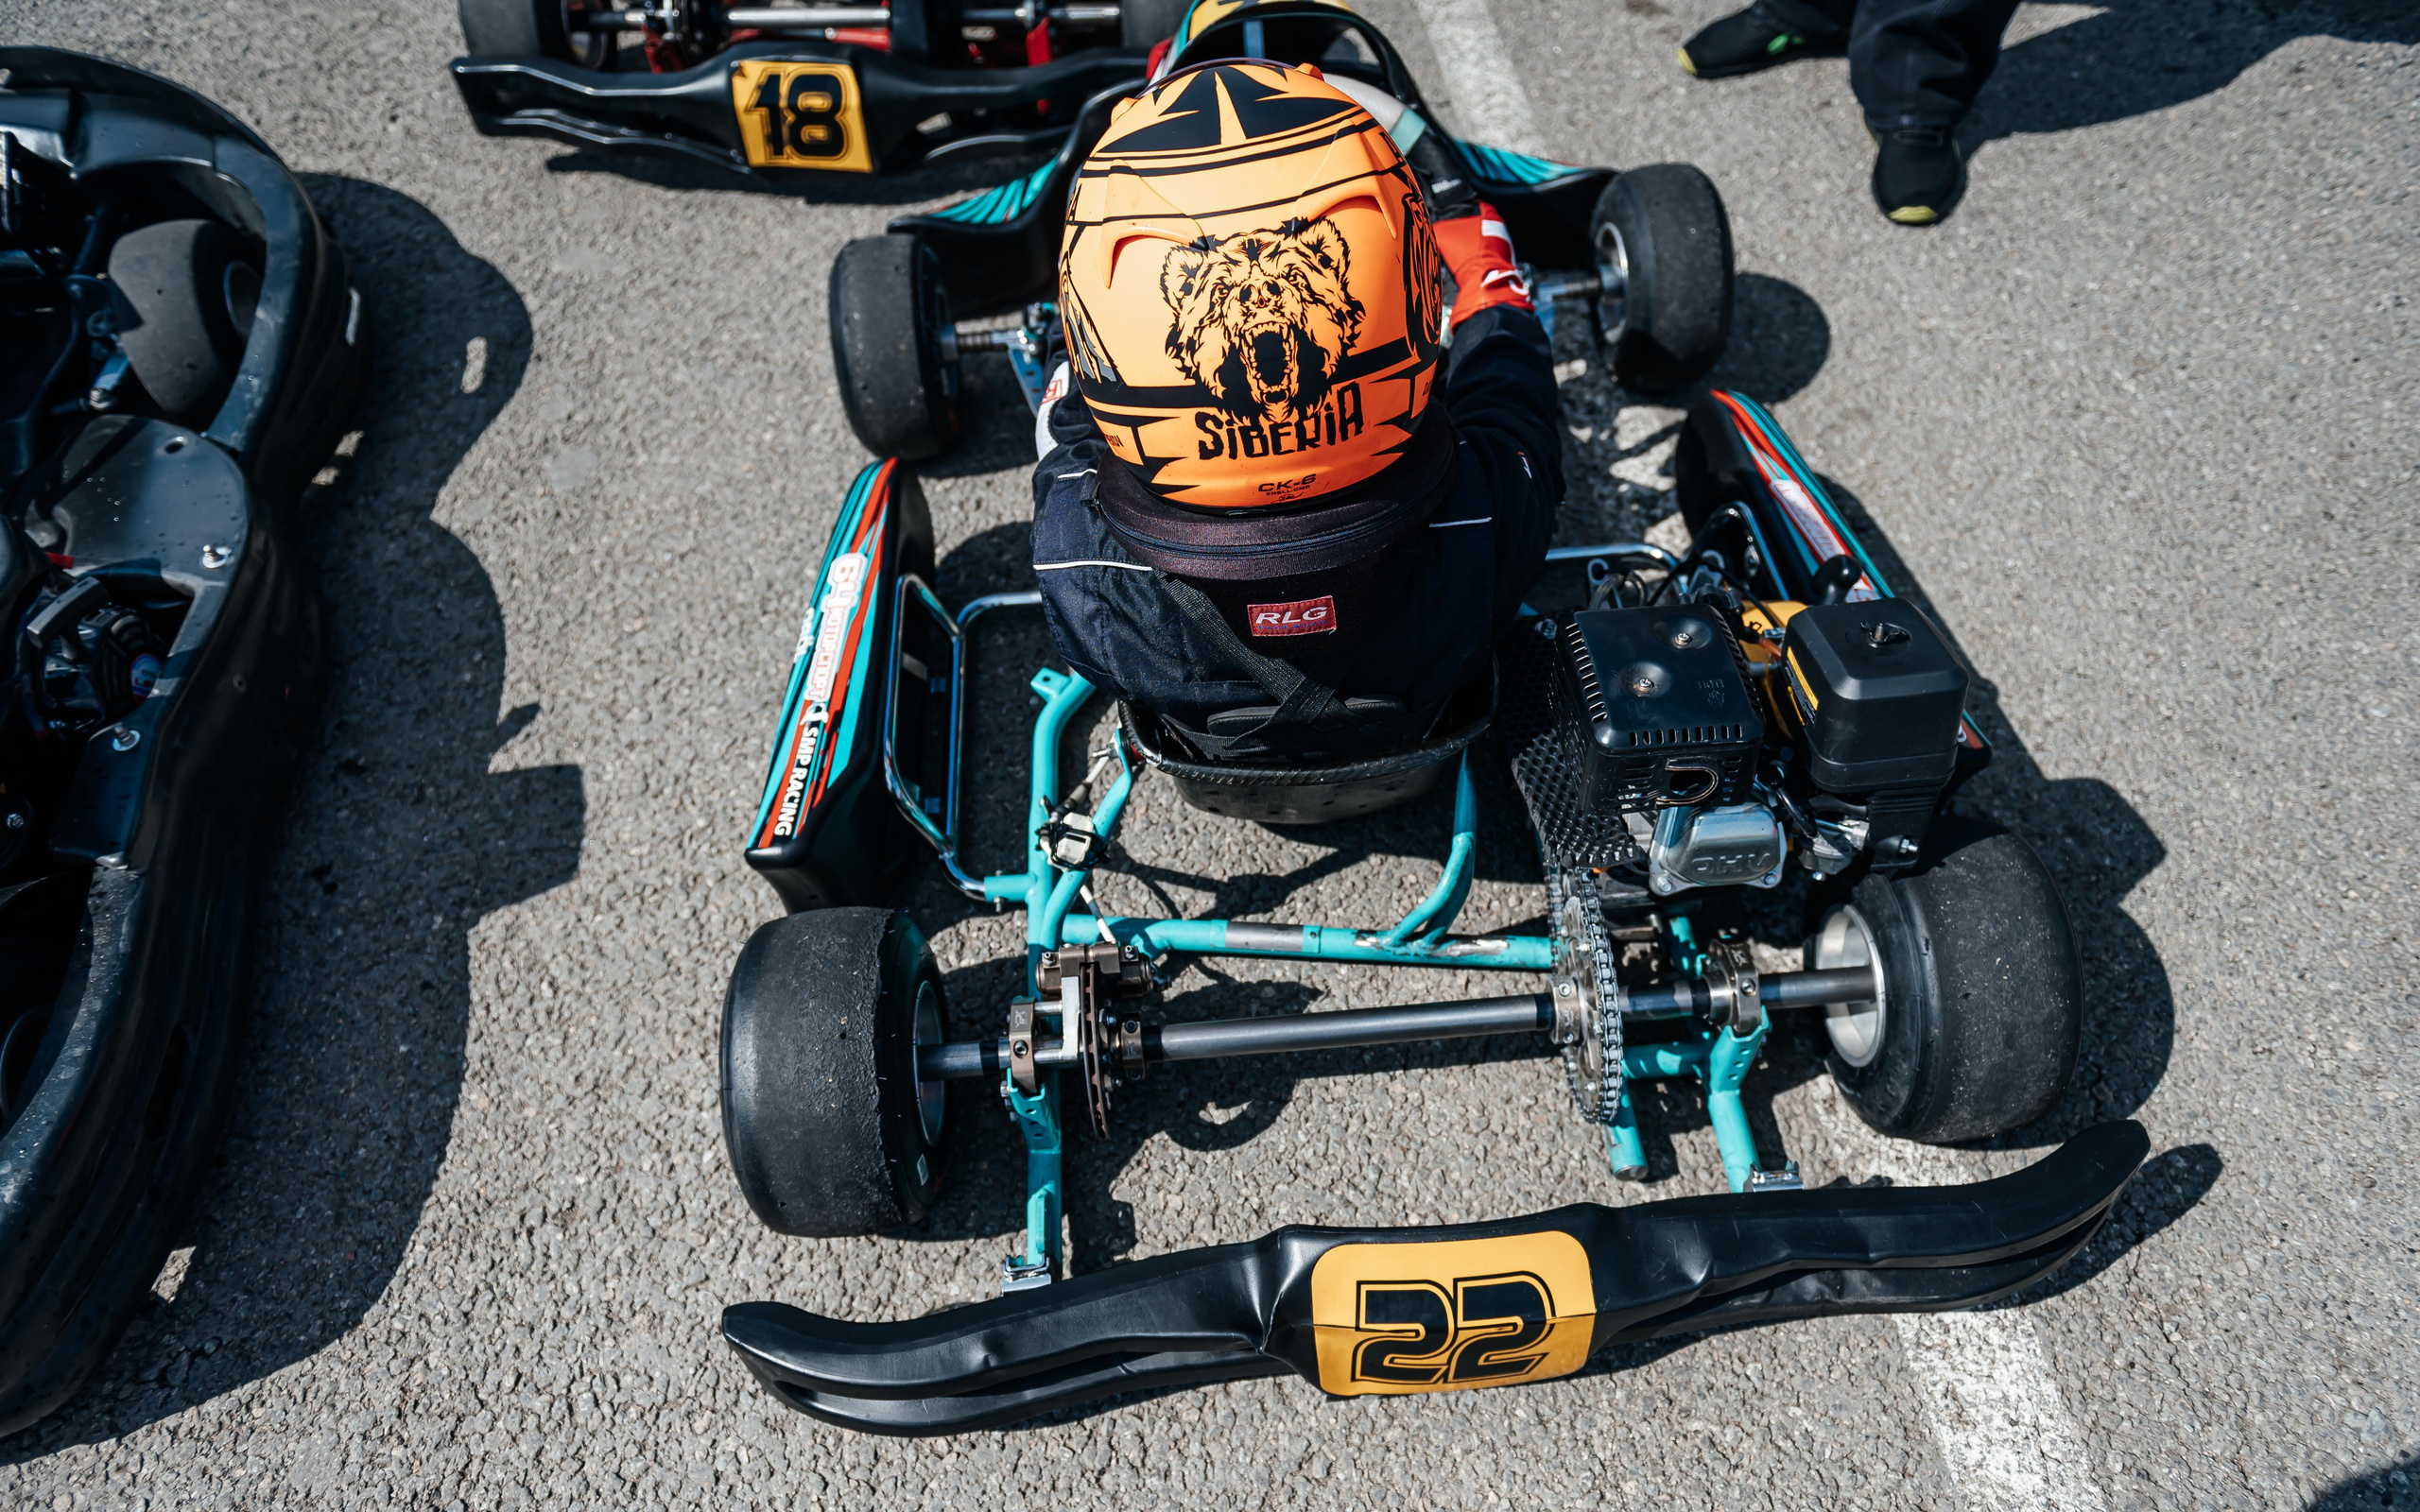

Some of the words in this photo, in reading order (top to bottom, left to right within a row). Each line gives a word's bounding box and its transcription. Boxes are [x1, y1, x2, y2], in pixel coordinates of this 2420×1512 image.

[744, 65, 851, 163] 18
[1258, 473, 1316, 491] CK-6
[1255, 607, 1328, 625] RLG
[796, 727, 820, 765] SMP
[774, 767, 808, 836] RACING
[1351, 1270, 1558, 1384] 22
